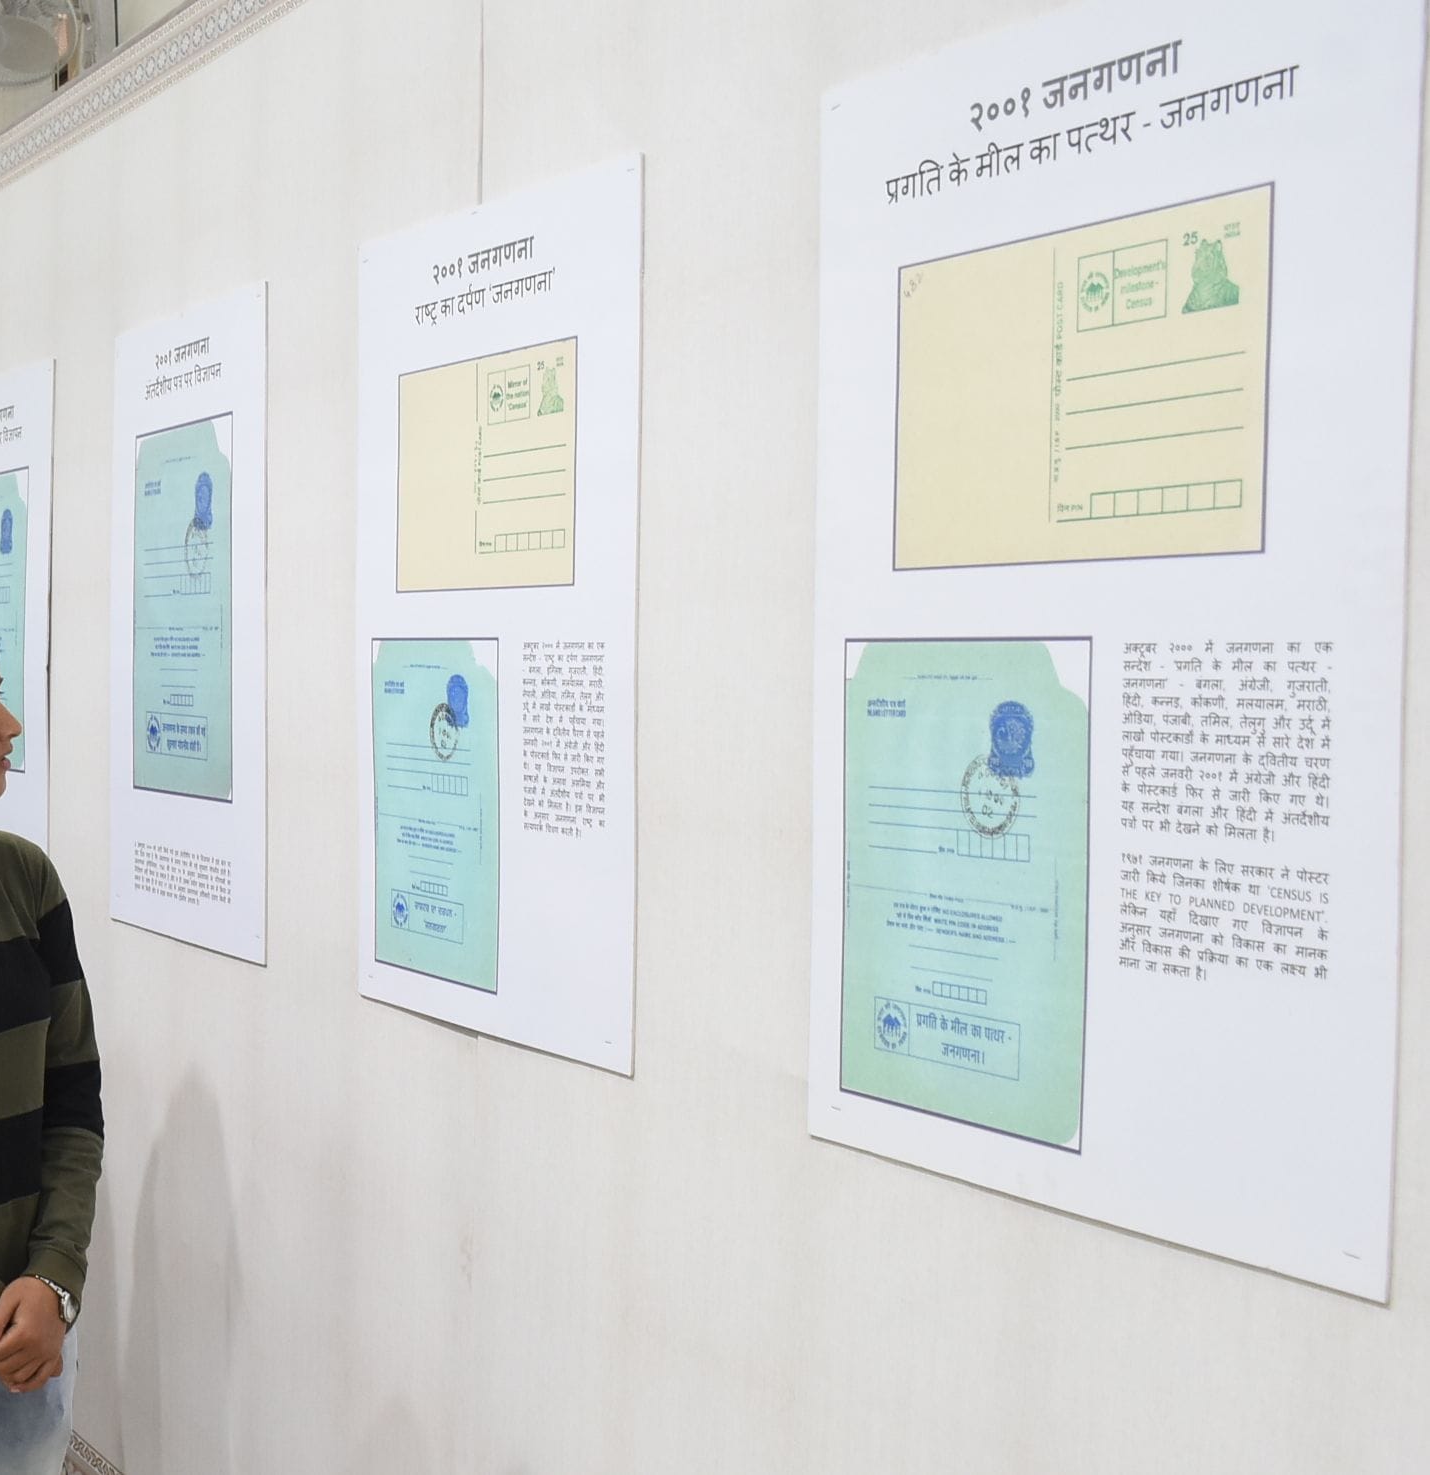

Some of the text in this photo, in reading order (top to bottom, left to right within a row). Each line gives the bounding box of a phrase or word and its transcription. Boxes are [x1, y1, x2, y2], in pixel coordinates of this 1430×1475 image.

[970, 39, 1182, 132] २००१ जनगणना
[886, 64, 1299, 205] प्रगति के मील का पत्थर जनगणना
[1183, 231, 1199, 246] 25
[433, 236, 534, 284] २००१ जनगणना
[415, 302, 438, 326] राष्ट्र
[440, 297, 455, 316] का
[457, 284, 486, 314] दर्पण
[155, 337, 210, 370] २००१ जनगणना
[173, 375, 183, 391] पत्र
[184, 369, 193, 389] पर
[194, 362, 222, 385] विज्ञापन
[1124, 640, 1333, 657] अक्टूबर २००० में जनगणना का एक
[1123, 659, 1316, 672] सन्देश के मील का पत्थर
[1288, 678, 1331, 697] गुजराती,
[1237, 698, 1287, 711] मलयालम,
[1297, 696, 1330, 713] मराठी,
[1240, 714, 1265, 734] तेलुगु
[1273, 715, 1291, 730] और
[1300, 715, 1316, 735] उर्दू
[1321, 716, 1331, 730] में
[1200, 731, 1209, 744] के
[1215, 734, 1250, 746] माध्यम
[1257, 733, 1265, 747] से
[1272, 734, 1290, 749] सारे
[1297, 734, 1314, 749] देश
[1321, 735, 1330, 750] में
[1161, 750, 1183, 762] गया।
[1190, 751, 1236, 764] जनगणना
[1243, 750, 1252, 764] के
[1305, 756, 1330, 769] चरण
[1122, 763, 1129, 775] से
[1135, 764, 1155, 778] पहले
[1161, 766, 1193, 780] जनवरी
[1199, 770, 1222, 781] २००१
[1229, 770, 1238, 783] में
[1282, 772, 1301, 787] और
[1122, 780, 1130, 793] के
[1137, 781, 1178, 796] पोस्टकार्ड
[1186, 785, 1203, 800] फिर
[1212, 787, 1221, 801] से
[1229, 788, 1250, 802] जारी
[1260, 789, 1280, 805] किए
[1290, 794, 1306, 805] गए
[1122, 800, 1134, 812] यह
[1141, 800, 1169, 815] सन्देश
[1211, 805, 1229, 819] और
[1265, 808, 1273, 823] में
[1142, 819, 1154, 831] पर
[1159, 818, 1170, 832] भी
[1176, 820, 1200, 835] देखने
[1206, 823, 1218, 836] को
[1225, 823, 1257, 840] मिलता
[1263, 826, 1274, 843] है।
[1150, 855, 1193, 871] जनगणना
[1199, 857, 1208, 871] के
[1215, 858, 1234, 874] लिए
[1241, 863, 1274, 880] सरकार
[1281, 865, 1290, 880] ने
[1297, 867, 1330, 885] पोस्टर
[1120, 869, 1140, 882] जारी
[1147, 870, 1165, 885] किये
[1173, 872, 1205, 889] जिनका
[1213, 877, 1241, 893] शीर्षक
[1248, 885, 1260, 896] था
[1320, 893, 1329, 904] IS
[1121, 888, 1137, 900] THE
[1145, 891, 1161, 903] KEY
[1169, 894, 1181, 906] TO
[1189, 896, 1235, 911] PLANNED
[1120, 903, 1147, 918] लेकिन
[1189, 911, 1220, 928] दिखाए
[1233, 918, 1248, 931] गए
[1262, 920, 1304, 938] विज्ञापन
[1318, 927, 1328, 941] के
[1120, 922, 1328, 960] अनुसार जनगणना को विकास का मानक
[1119, 937, 1327, 980] और विकास की प्रक्रिया का एक लक्ष्य भी
[1119, 956, 1206, 982] माना जा सकता है।
[916, 1012, 938, 1030] प्रगति
[939, 1015, 949, 1031] के
[951, 1017, 968, 1036] मील
[971, 1024, 982, 1039] का
[941, 1042, 985, 1064] जनगणना।
